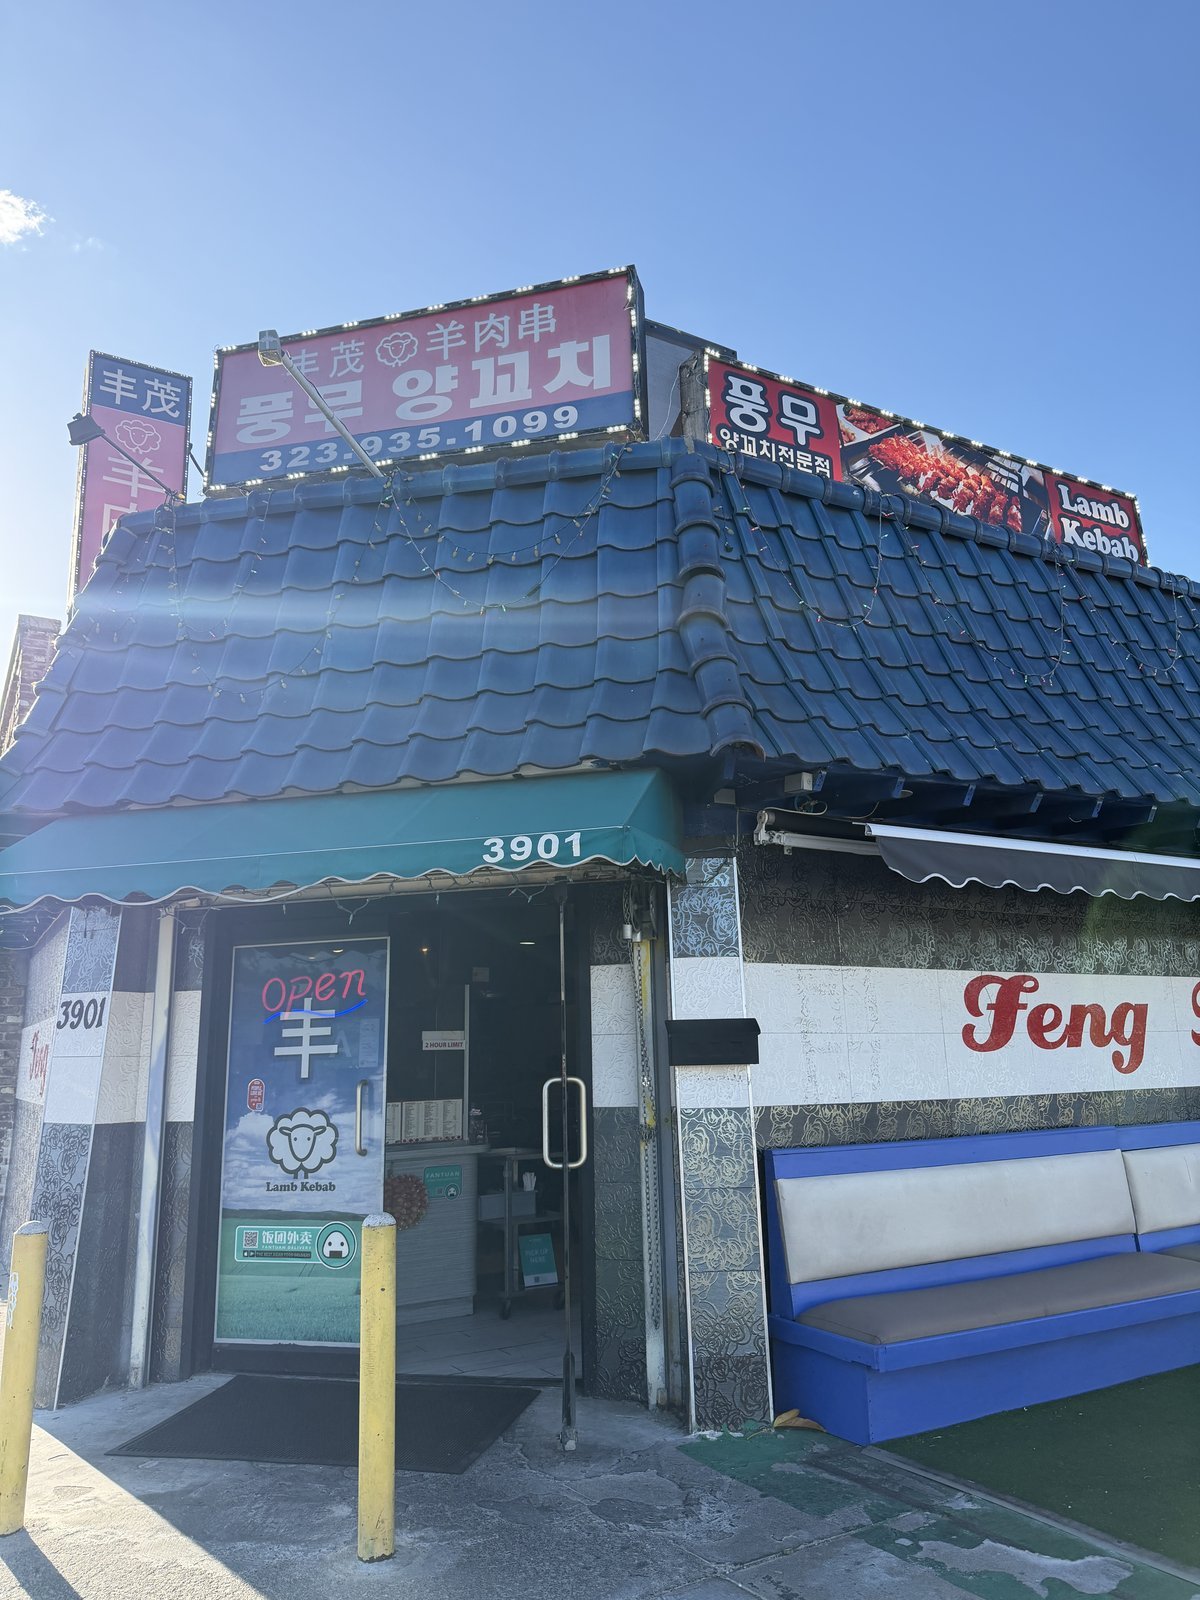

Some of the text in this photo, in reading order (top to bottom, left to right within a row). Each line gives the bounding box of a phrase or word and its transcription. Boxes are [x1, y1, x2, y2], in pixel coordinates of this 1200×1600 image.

[426, 303, 556, 361] 羊肉串
[100, 369, 181, 418] 丰茂
[236, 335, 611, 443] 풍무 양꼬치
[725, 375, 821, 446] 풍무
[259, 405, 578, 472] 323.935.1099
[719, 428, 831, 479] 양꼬치전문점
[1058, 484, 1130, 528] Lamb
[1060, 517, 1139, 562] Kebab
[482, 831, 581, 863] 3901
[56, 997, 107, 1030] 3901
[273, 997, 338, 1079] 丰
[962, 974, 1149, 1074] Feng
[425, 1041, 464, 1049] 2 HOUR LIMIT
[266, 1181, 336, 1192] Lamb Kebab
[262, 1230, 312, 1245] 饭团外卖
